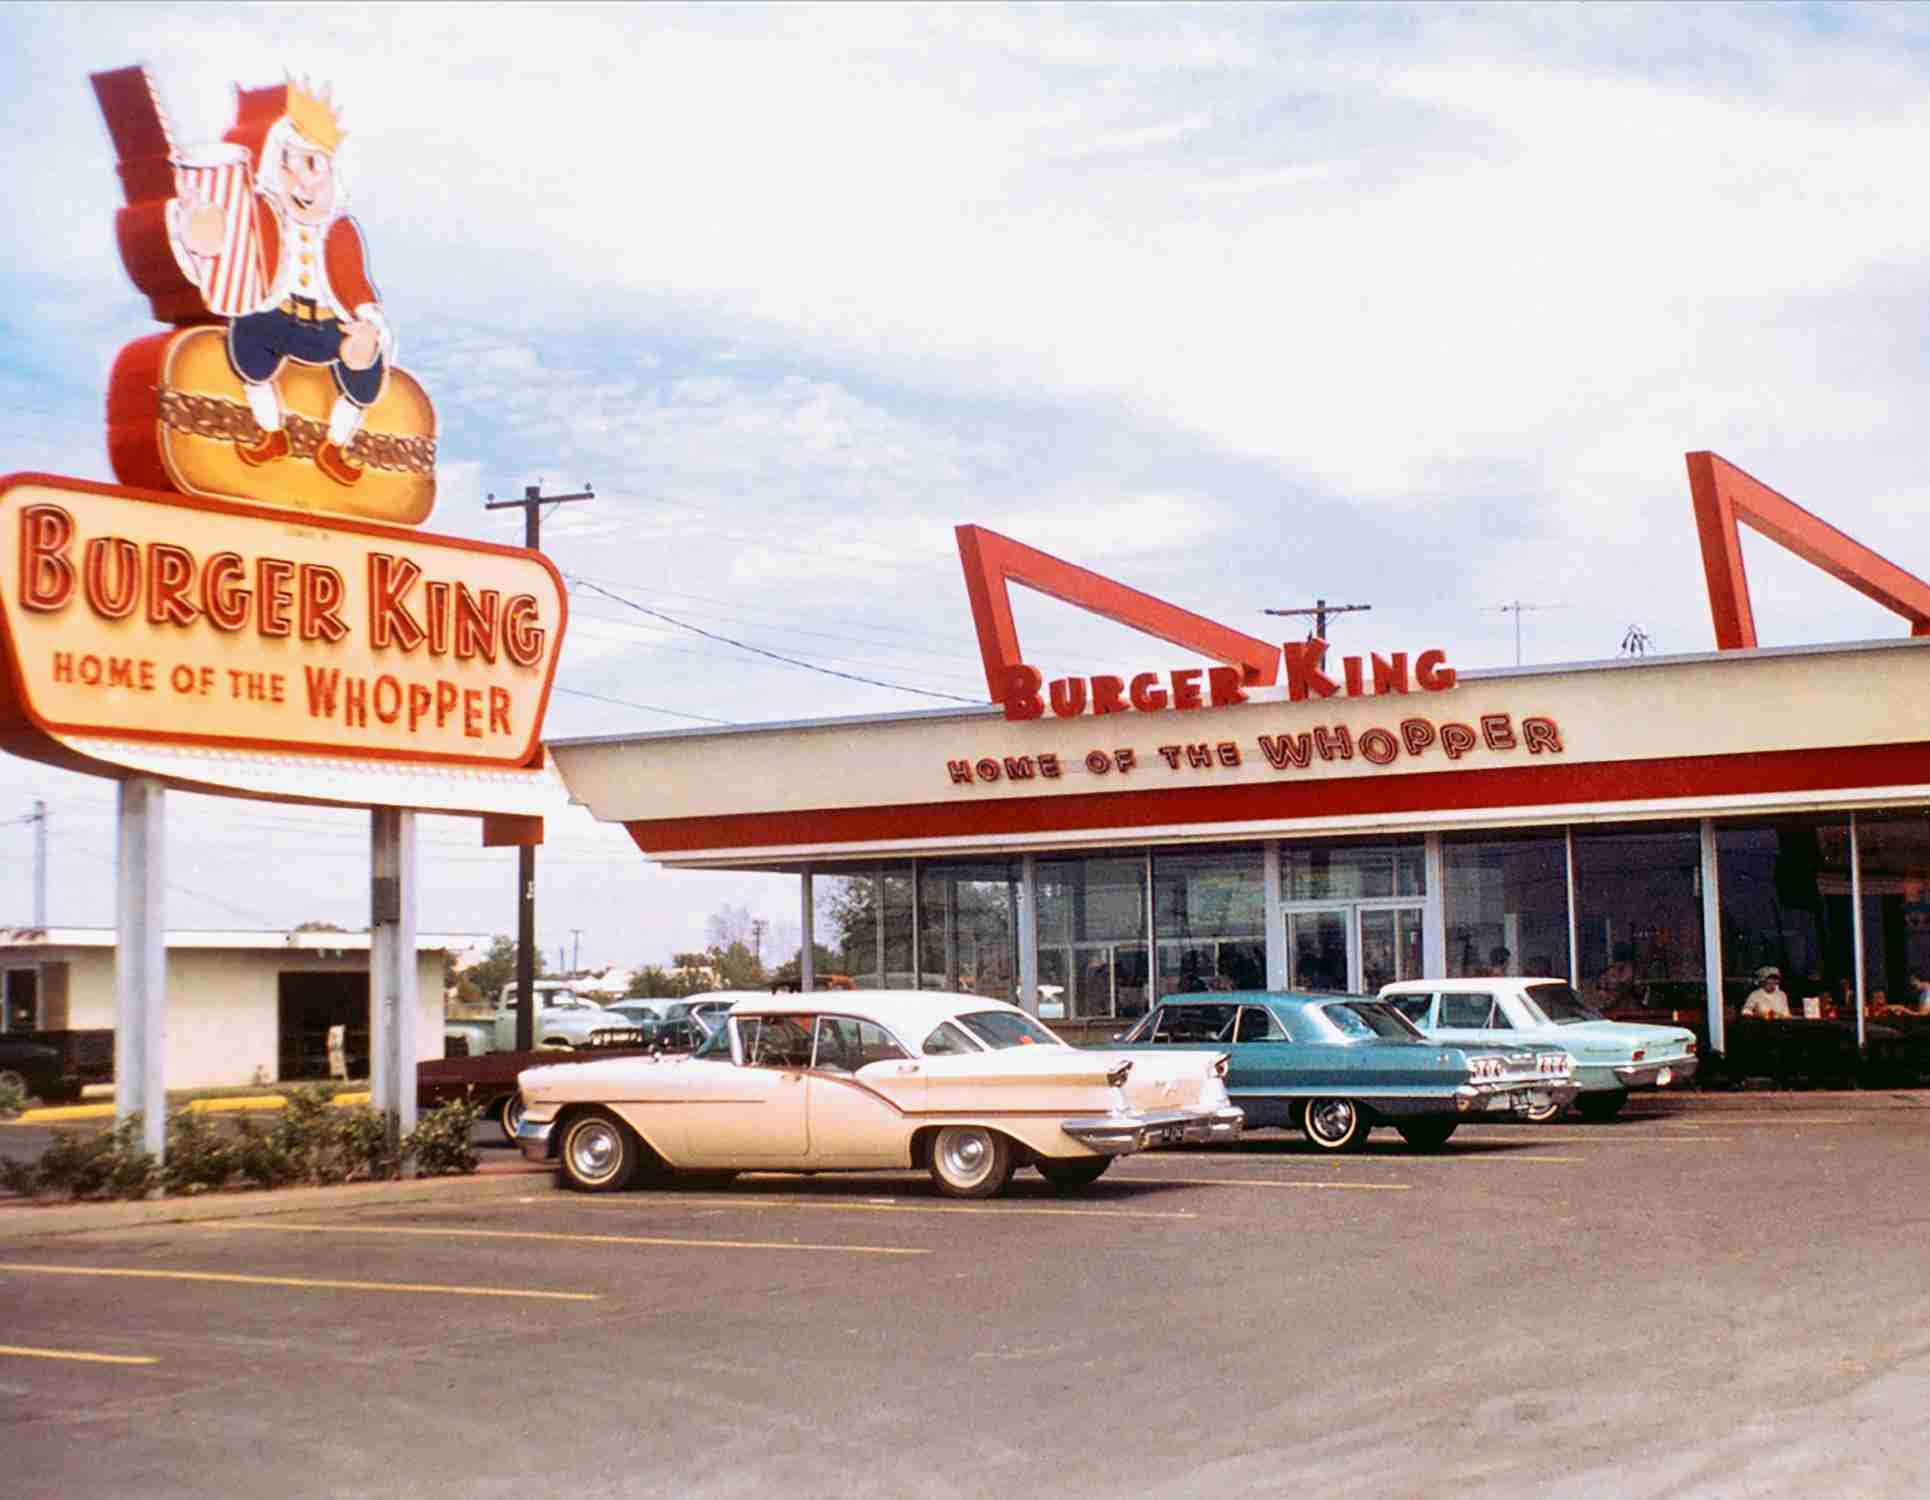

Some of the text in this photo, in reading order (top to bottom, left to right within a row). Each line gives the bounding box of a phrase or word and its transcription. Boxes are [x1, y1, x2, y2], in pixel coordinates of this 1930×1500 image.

[20, 503, 545, 668] BURGER KING
[53, 651, 513, 740] HOME OF THE WHOPPER
[1003, 637, 1457, 721] BURGER KING
[947, 713, 1564, 786] HOME OF THE WHOPPER
